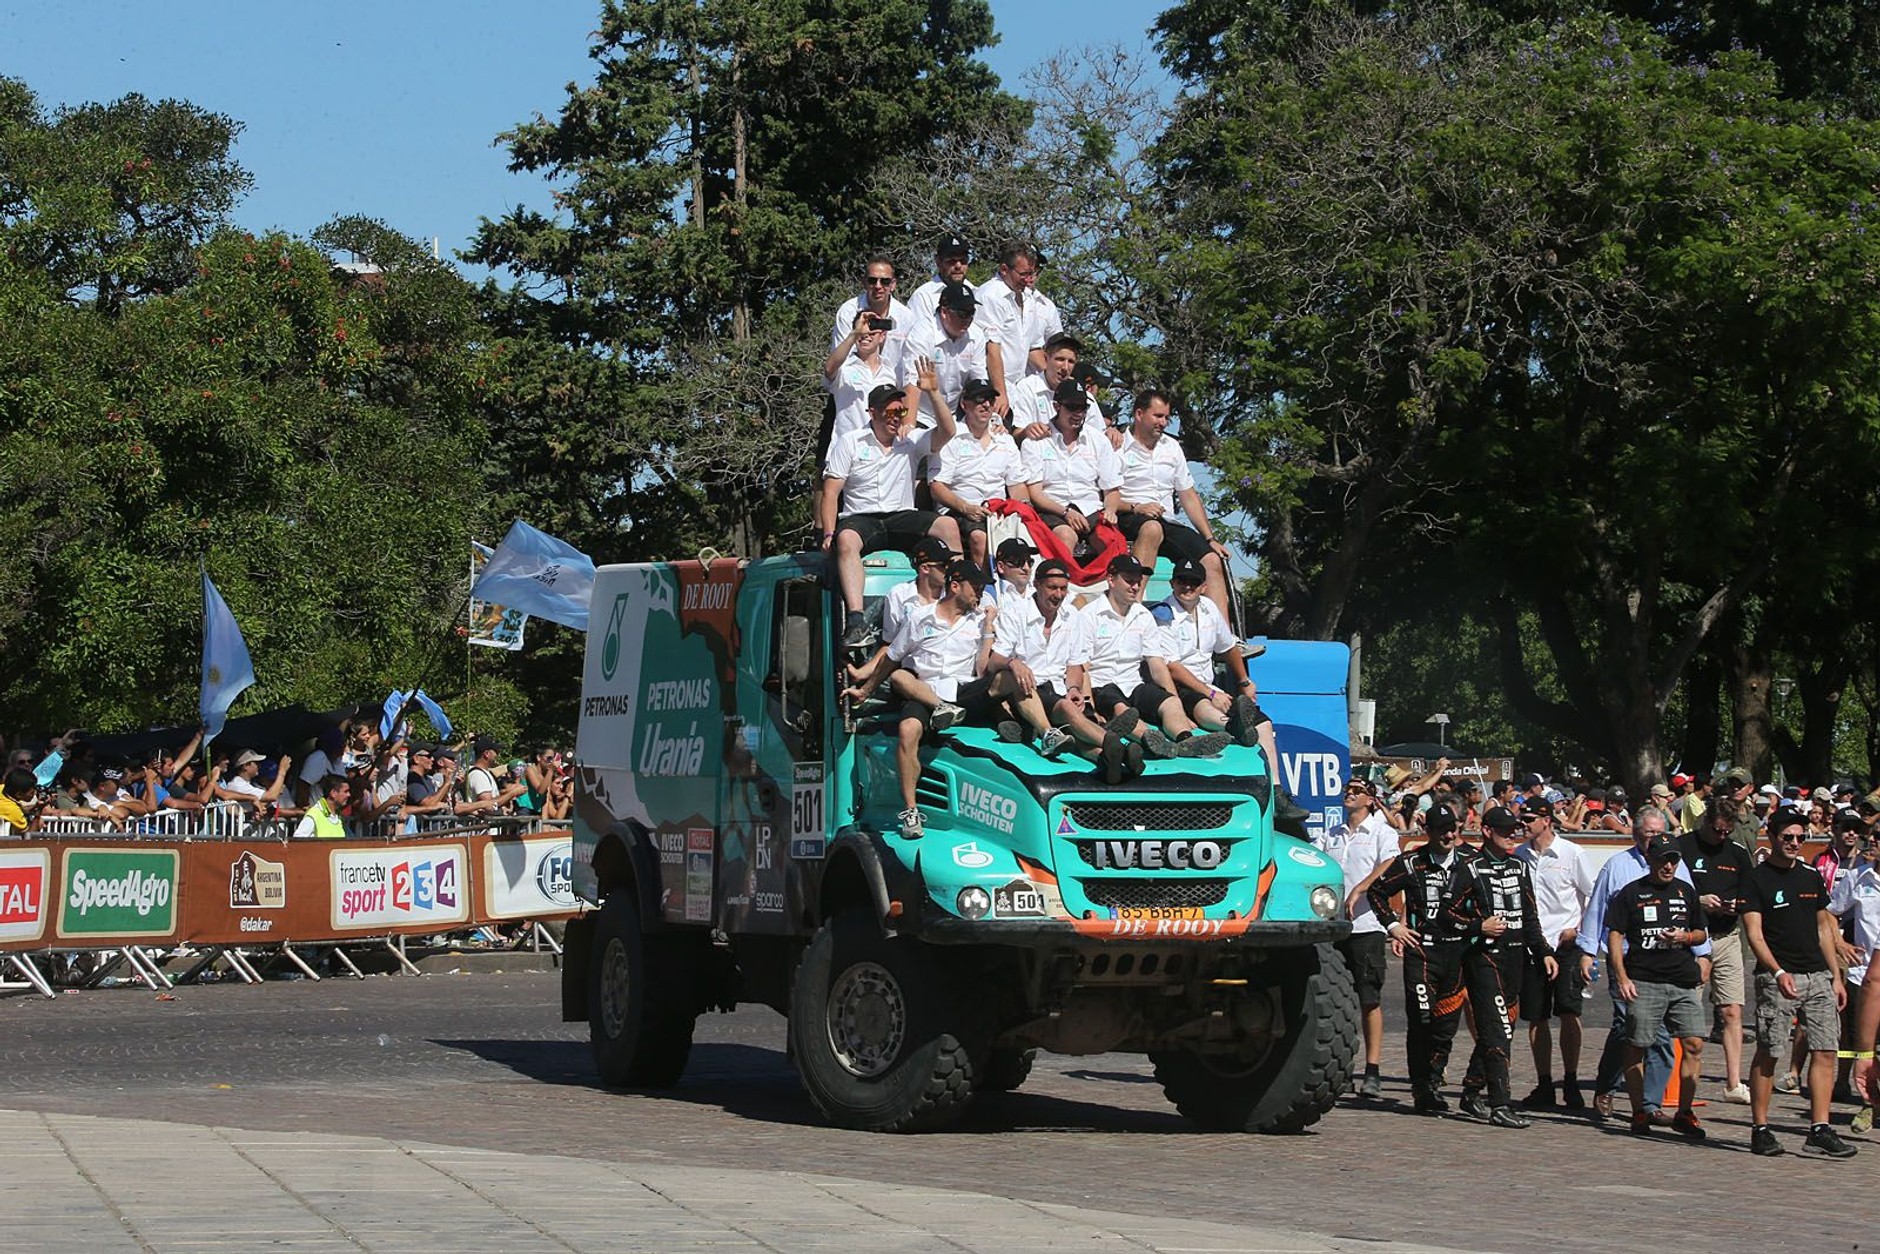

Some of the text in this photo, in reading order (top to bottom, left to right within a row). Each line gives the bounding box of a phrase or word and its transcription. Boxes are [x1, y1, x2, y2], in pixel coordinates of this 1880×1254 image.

[684, 583, 734, 610] DE ROOY
[585, 695, 628, 716] PETRONAS
[648, 679, 711, 711] PETRONAS
[640, 722, 705, 776] Urania
[1281, 753, 1342, 796] VTB
[794, 789, 822, 834] 501
[960, 782, 1017, 820] IVECO
[958, 801, 1014, 834] SCHOUTEN
[661, 834, 684, 851] IVECO
[691, 832, 711, 848] TOTAL
[756, 826, 771, 848] LP
[756, 848, 771, 869] DN
[1095, 841, 1221, 868] IVECO
[340, 863, 386, 883] francetv
[550, 857, 573, 883] FO
[70, 869, 169, 916] SpeedAgro
[418, 870, 433, 902] 3
[440, 867, 455, 900] 4
[550, 882, 571, 894] SPO
[342, 883, 386, 919] sport
[240, 916, 273, 932] @dakar
[1111, 919, 1226, 936] DE ROOY
[1416, 983, 1431, 1023] IVECO
[1494, 995, 1513, 1040] IVECO
